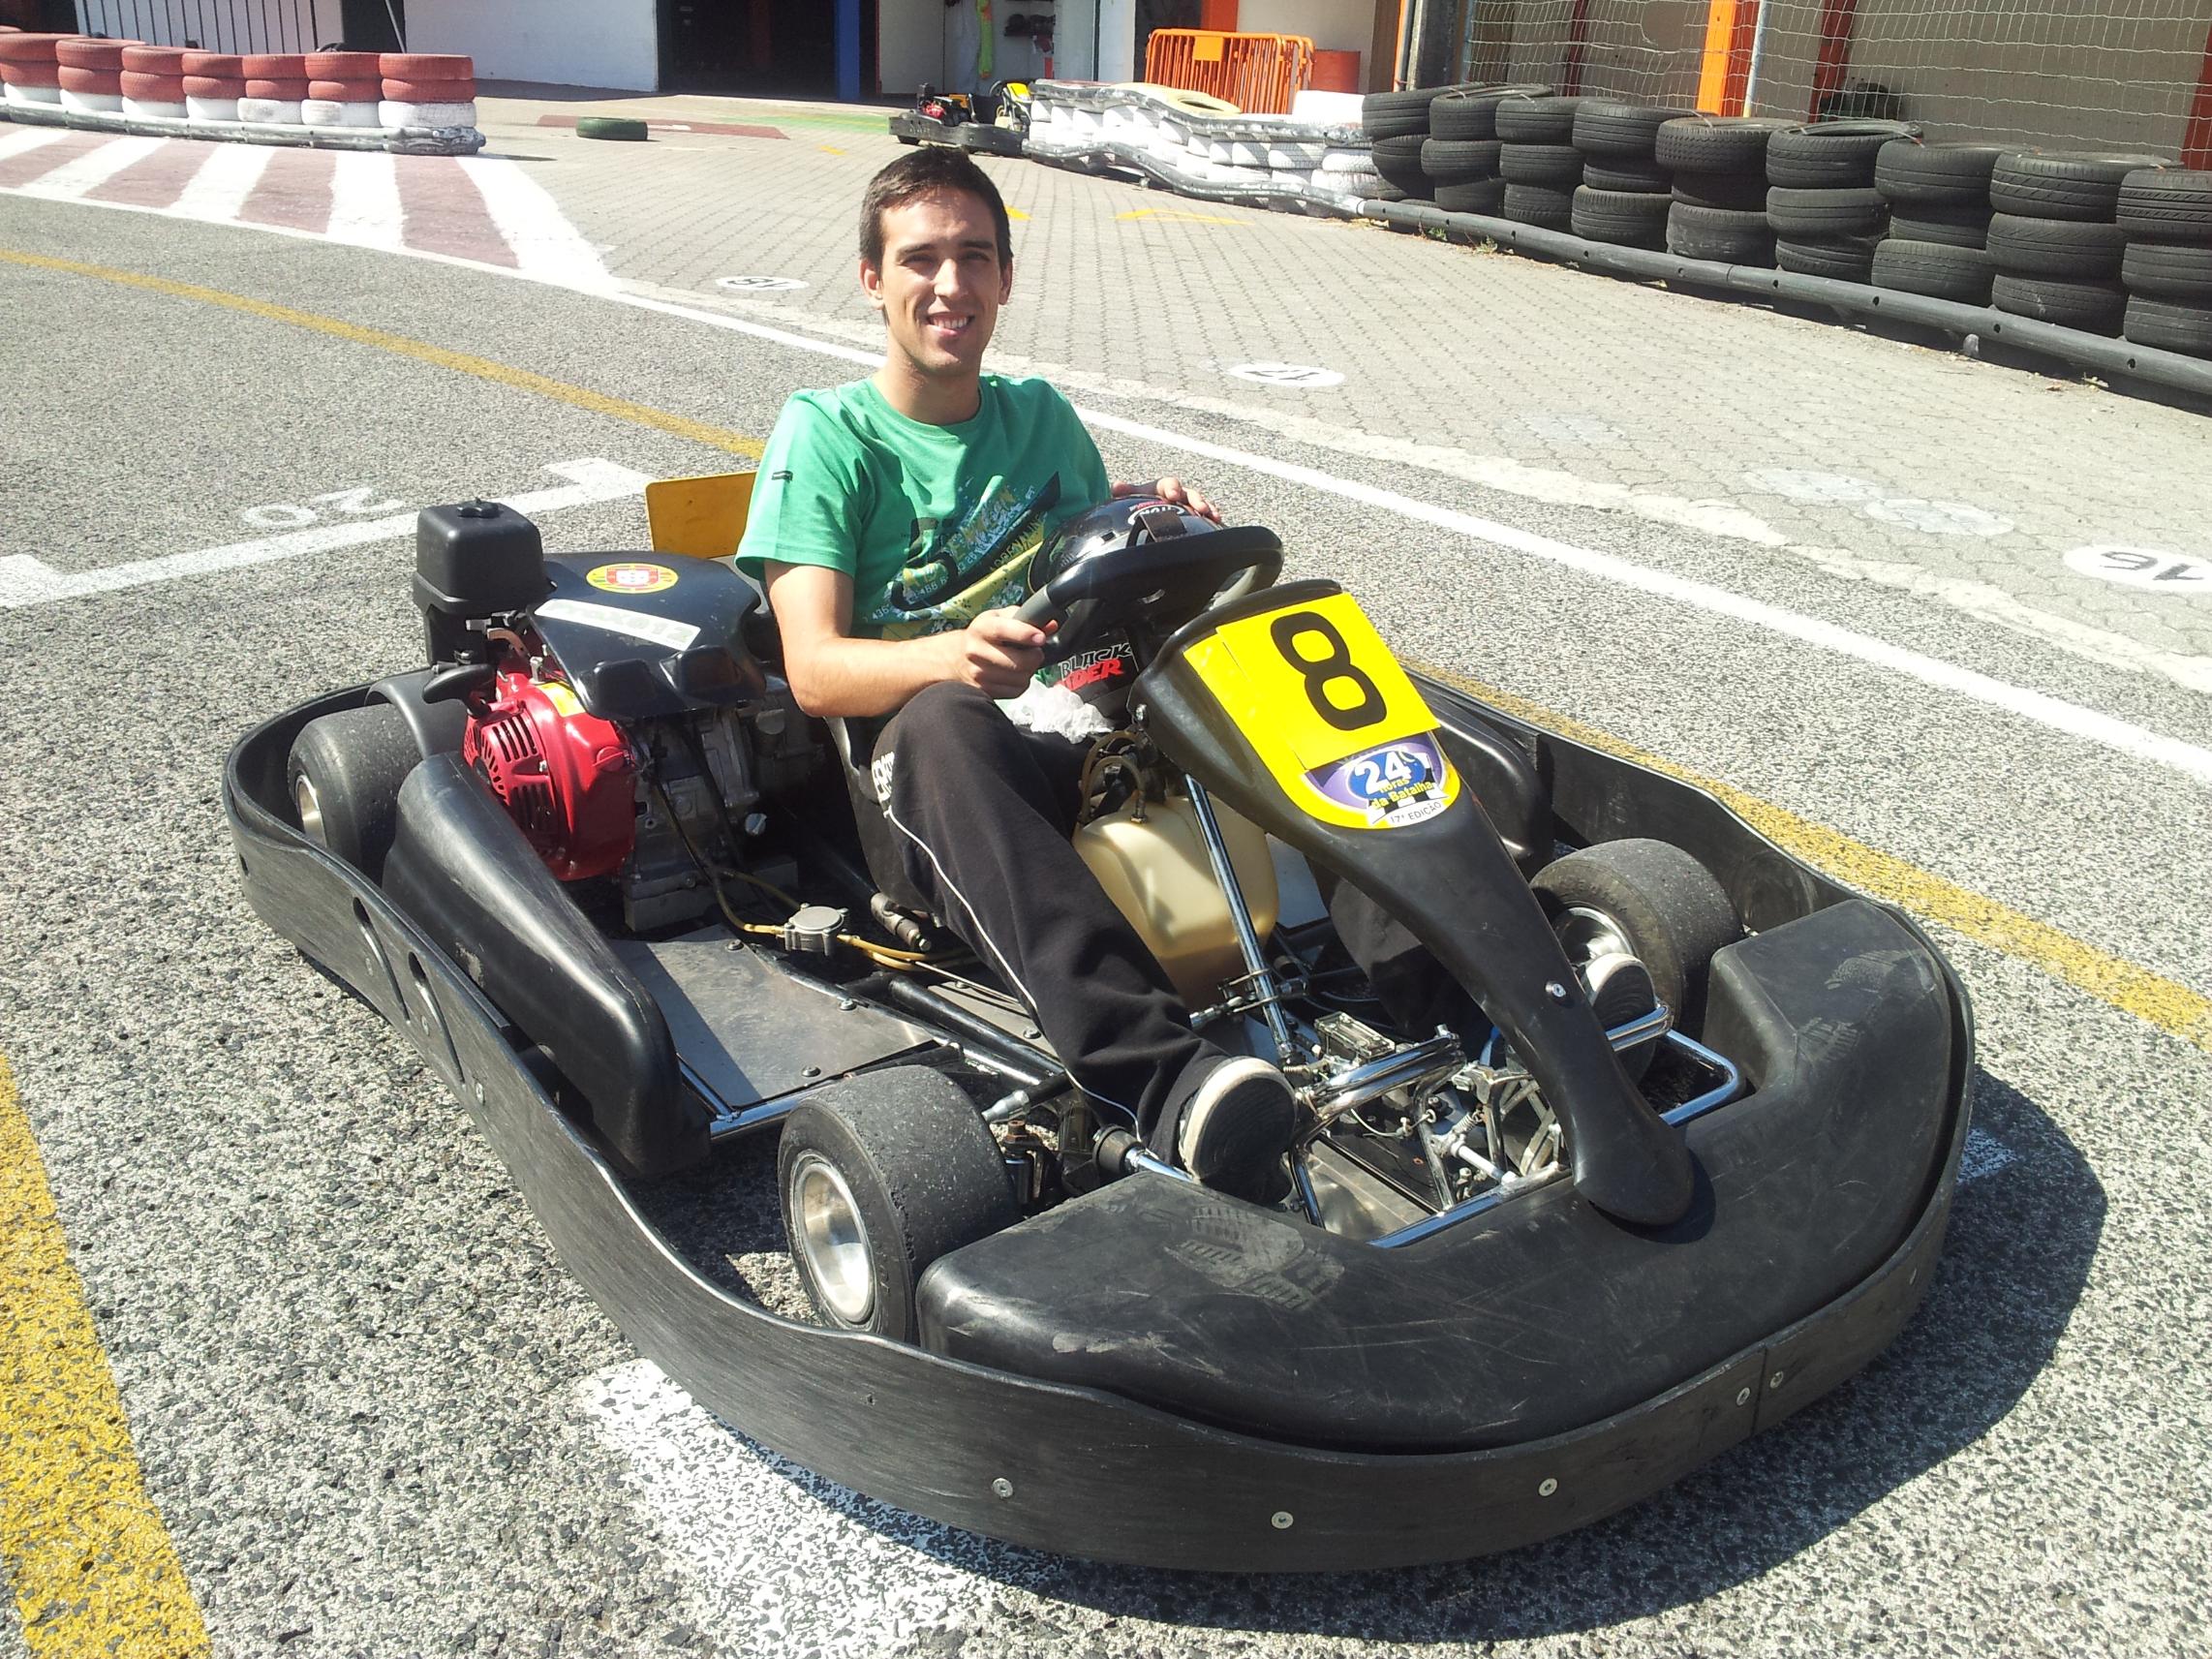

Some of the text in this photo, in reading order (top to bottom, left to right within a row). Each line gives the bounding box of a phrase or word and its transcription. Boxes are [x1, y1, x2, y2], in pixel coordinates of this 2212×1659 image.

[241, 486, 404, 528] 20
[2100, 549, 2204, 581] 16
[1053, 659, 1123, 691] IDER
[1058, 642, 1132, 681] BLACK
[1271, 611, 1387, 731] 8
[1354, 751, 1412, 795] 24
[1371, 781, 1433, 811] da Batalha
